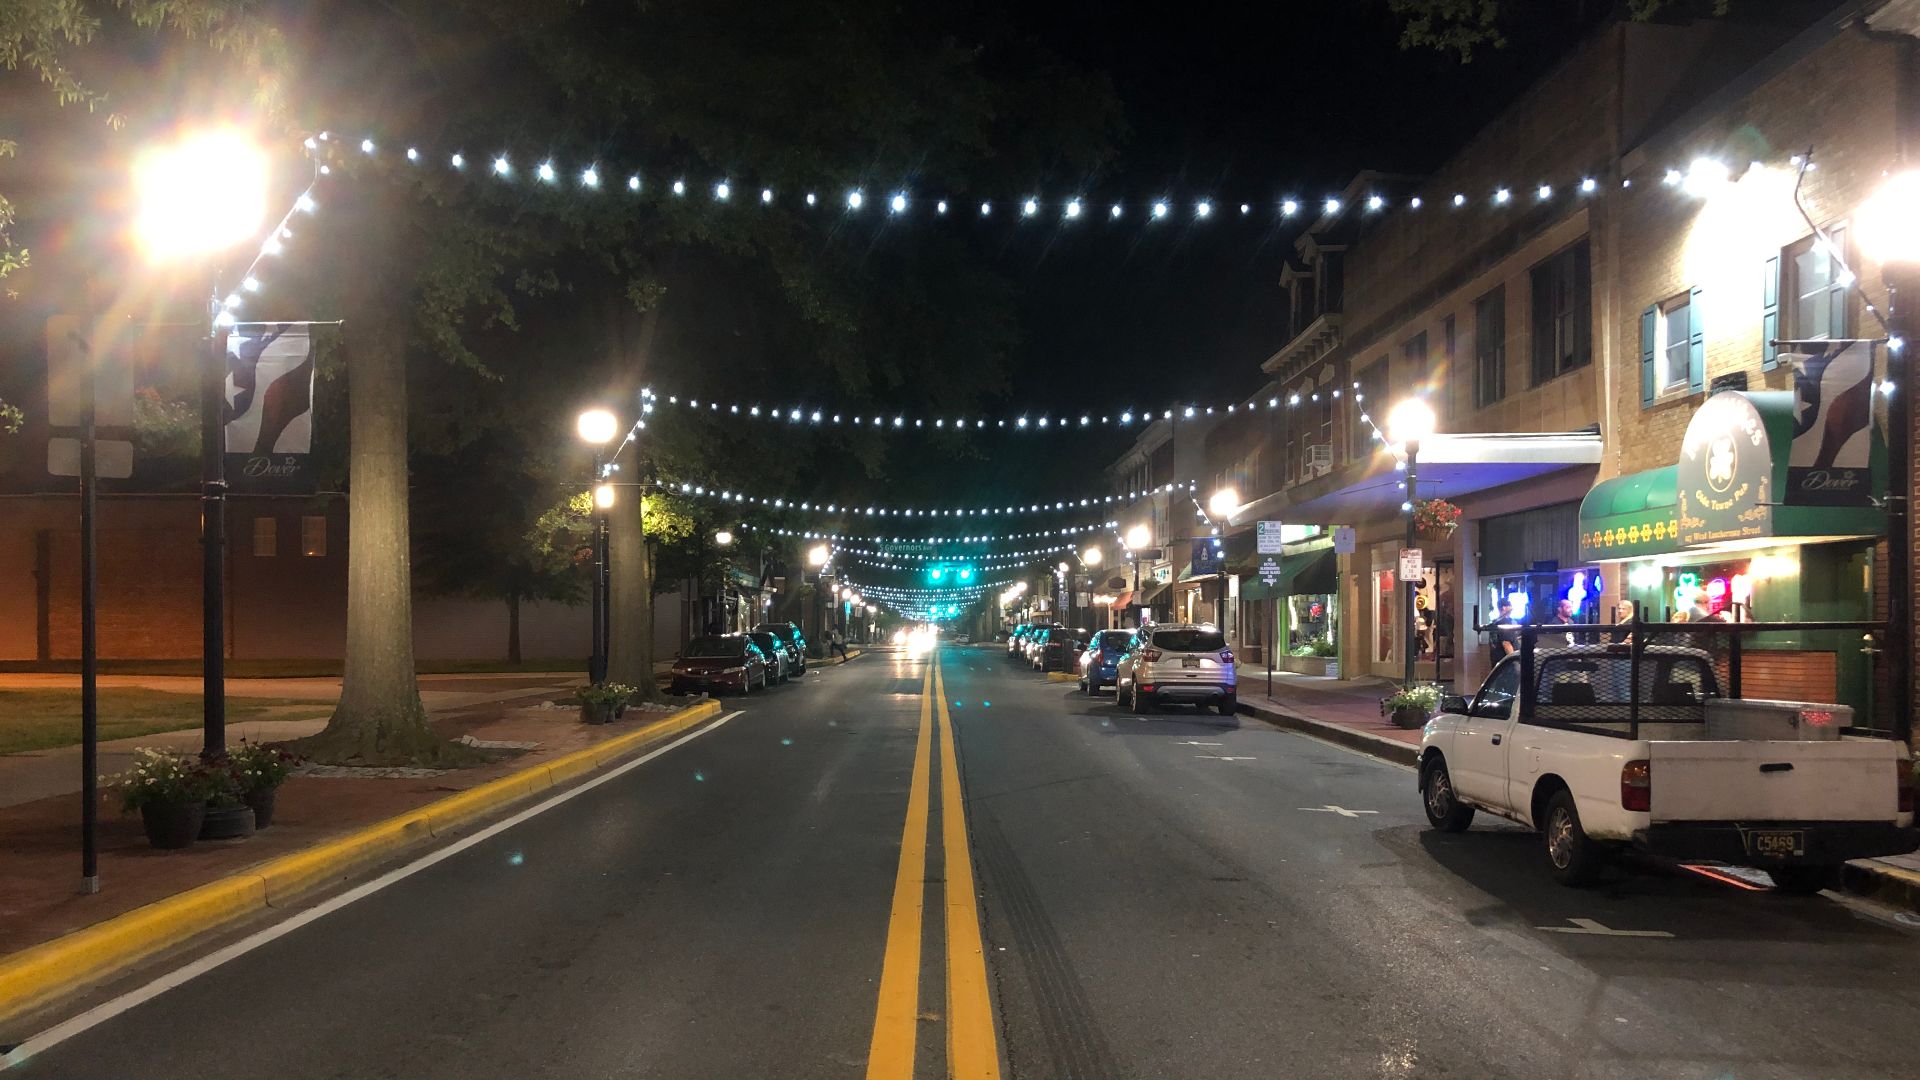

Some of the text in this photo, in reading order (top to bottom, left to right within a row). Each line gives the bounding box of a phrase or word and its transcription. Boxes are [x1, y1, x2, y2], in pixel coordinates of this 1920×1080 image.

[243, 456, 299, 477] Dover
[1801, 470, 1858, 490] Dover
[1258, 524, 1264, 534] 2
